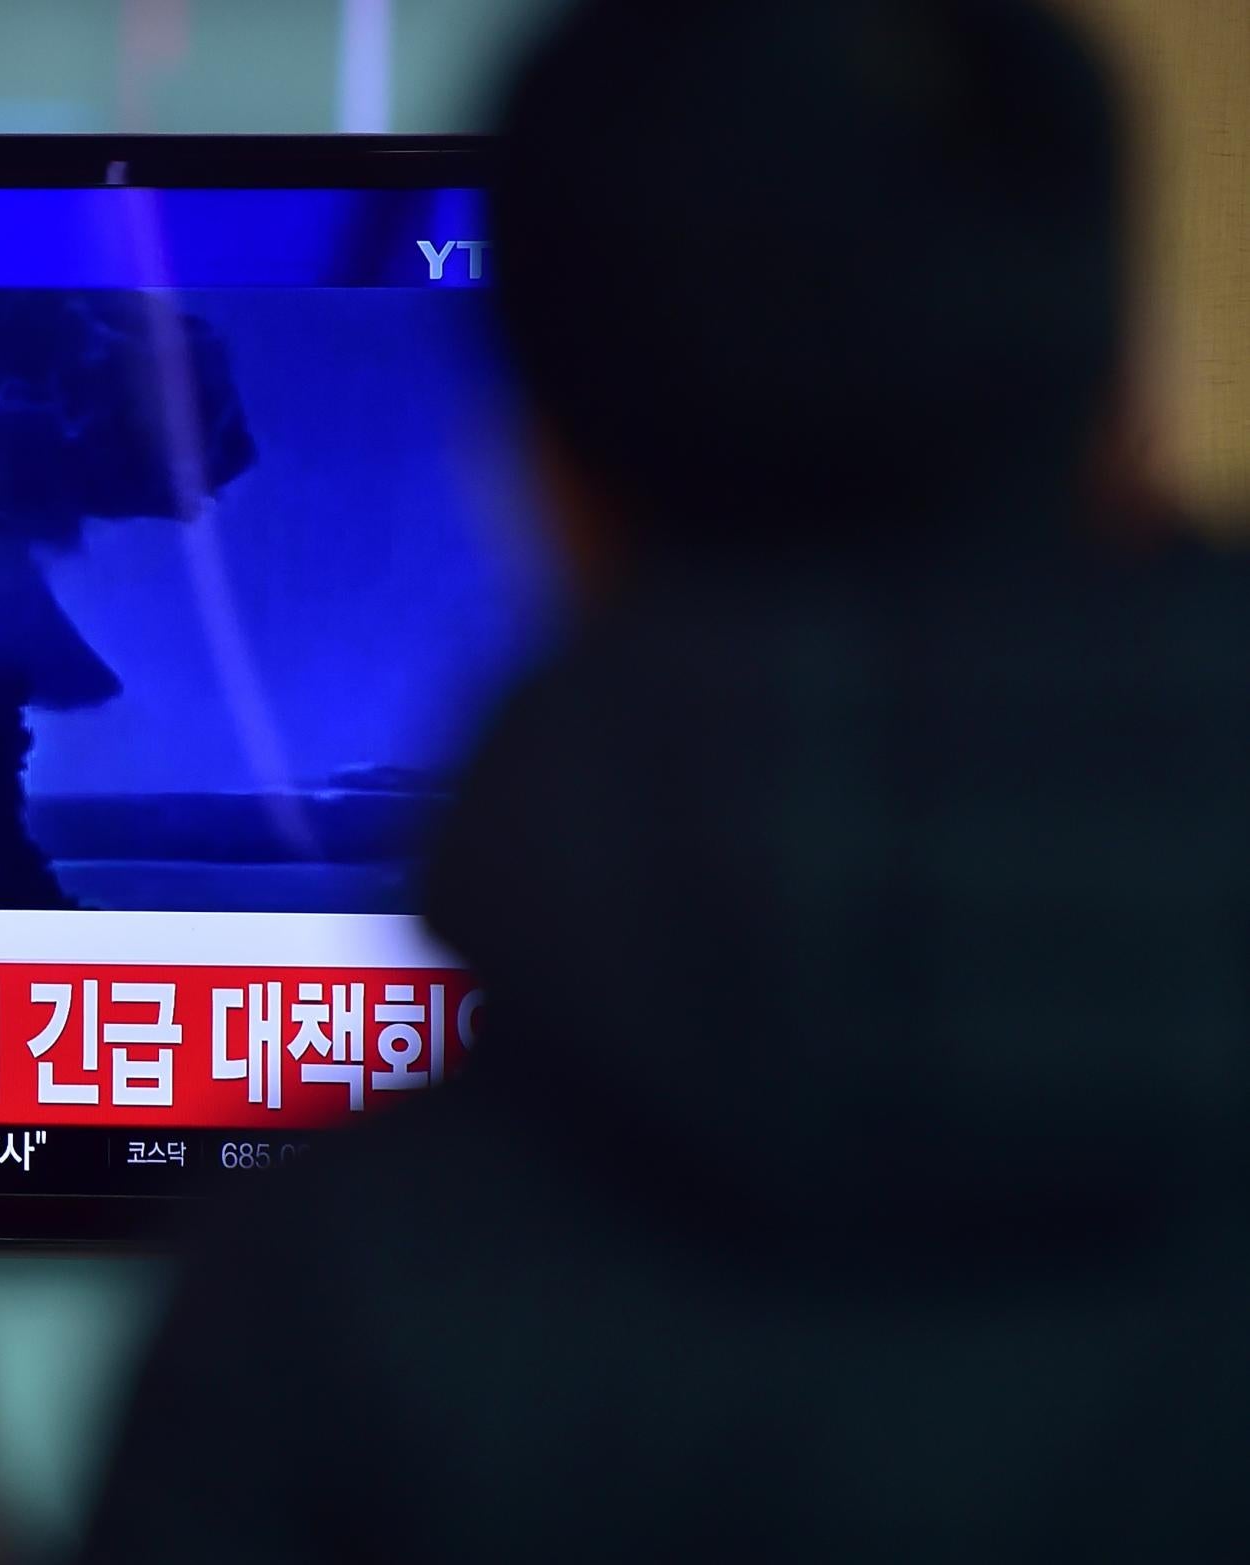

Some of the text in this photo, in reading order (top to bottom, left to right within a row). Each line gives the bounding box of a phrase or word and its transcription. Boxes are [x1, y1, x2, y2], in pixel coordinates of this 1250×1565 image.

[26, 979, 182, 1106] 긴급
[212, 981, 485, 1111] 대책회
[127, 1141, 187, 1167] 코스닥
